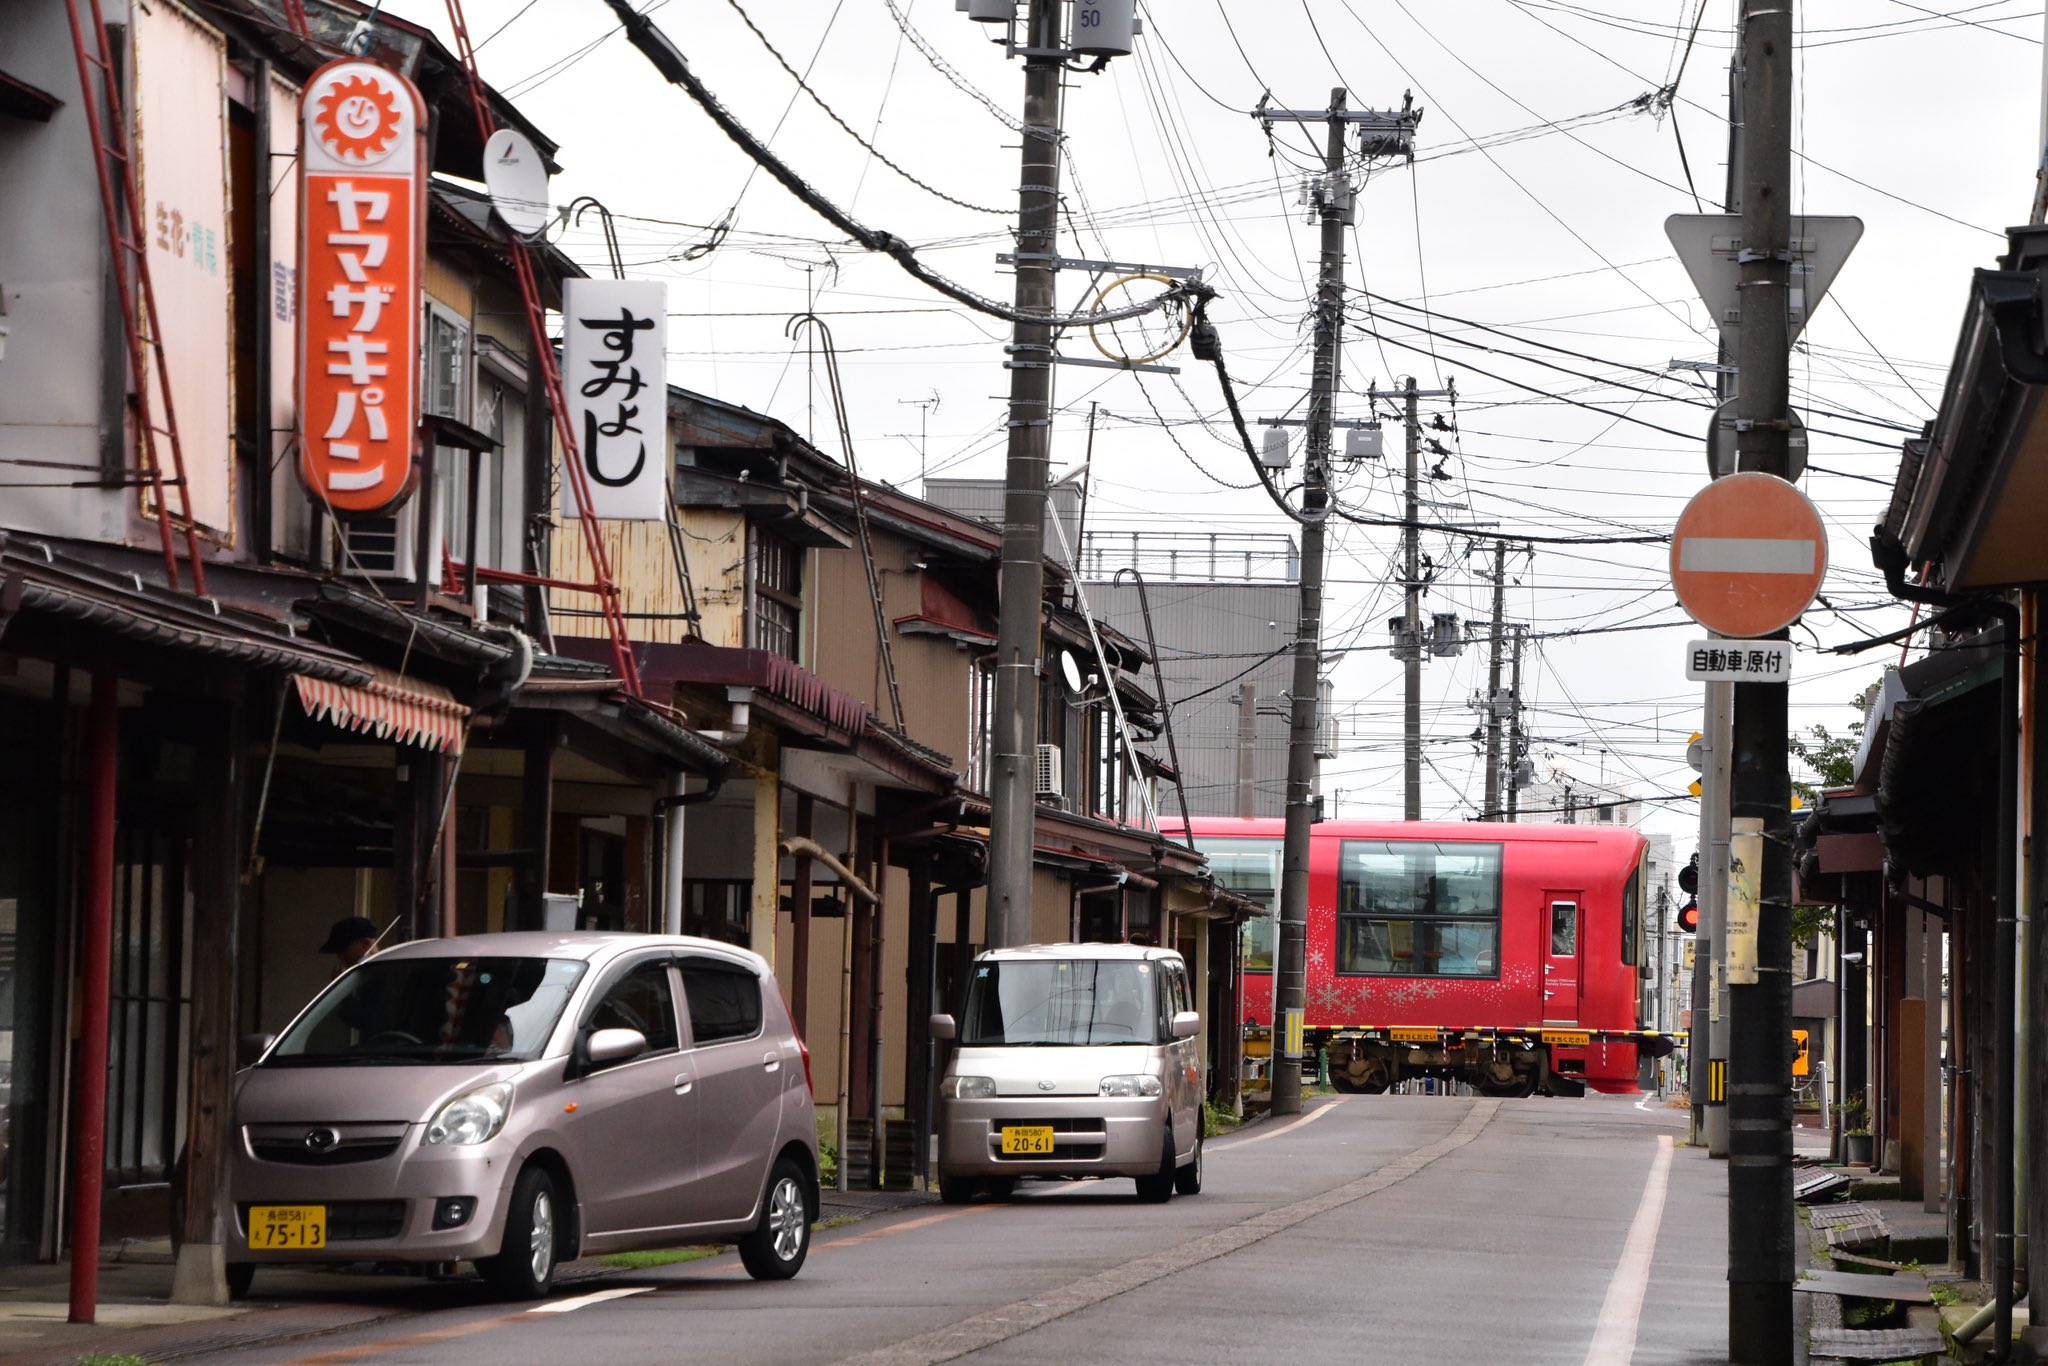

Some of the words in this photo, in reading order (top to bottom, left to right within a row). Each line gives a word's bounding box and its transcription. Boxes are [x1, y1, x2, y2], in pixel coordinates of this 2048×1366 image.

[1081, 9, 1100, 28] 50
[324, 182, 394, 490] ヤマザキパン
[578, 306, 655, 487] すみよし
[1692, 648, 1783, 674] 自動車・原付
[1014, 1138, 1048, 1151] 20-61
[266, 1223, 320, 1246] 75-13
